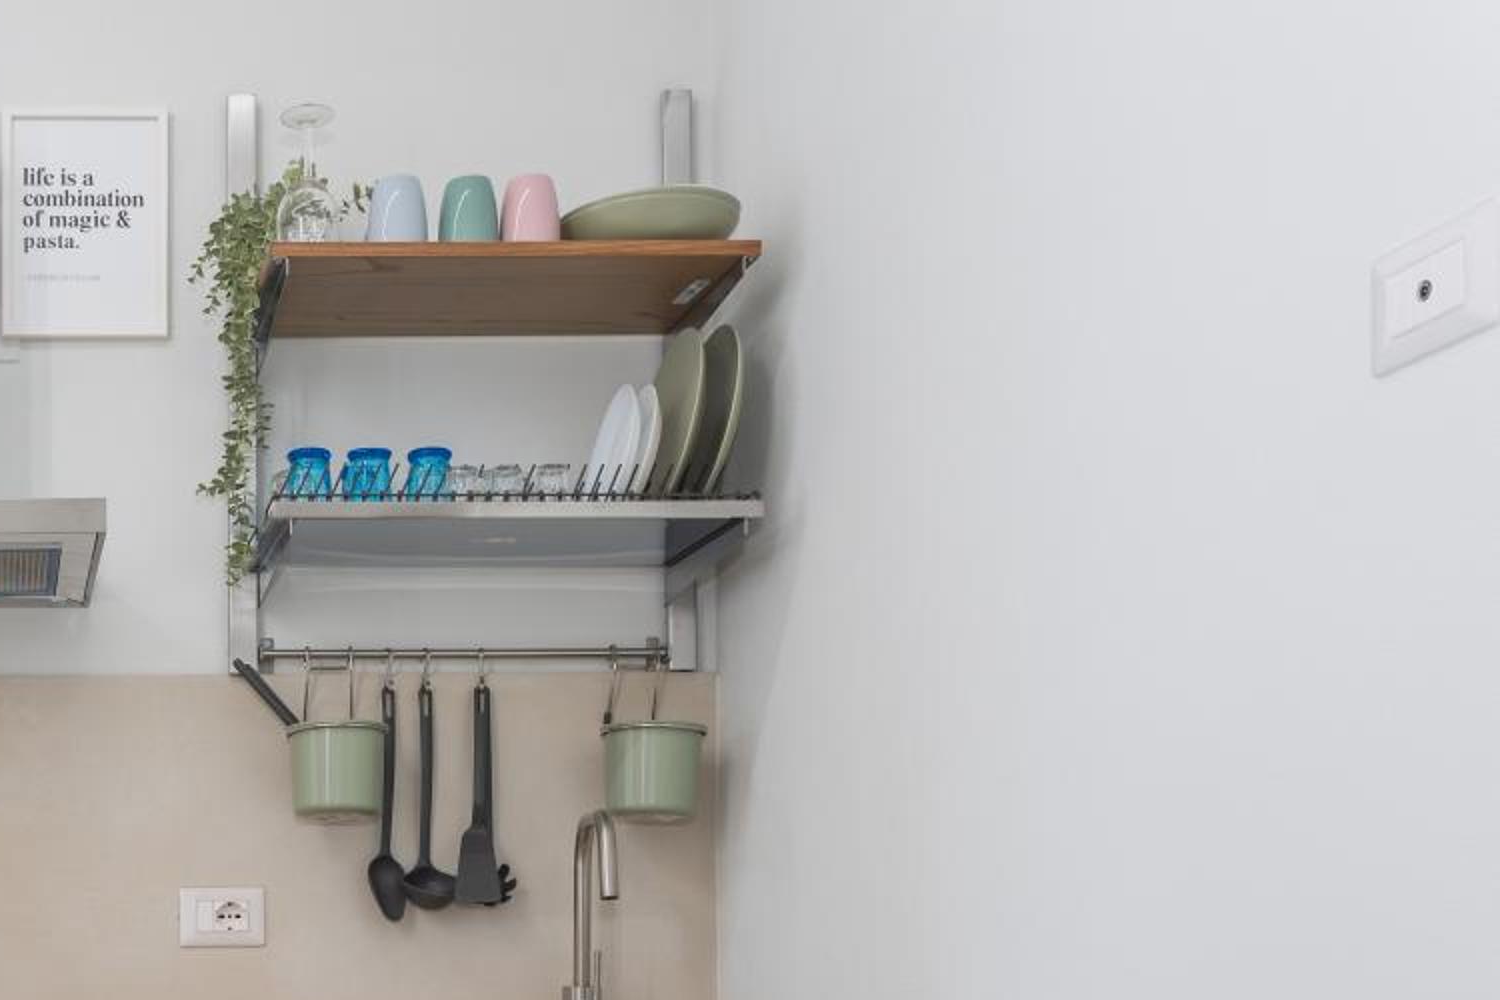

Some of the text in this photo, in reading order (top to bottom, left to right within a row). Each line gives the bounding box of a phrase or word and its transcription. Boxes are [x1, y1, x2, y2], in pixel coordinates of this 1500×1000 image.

[22, 167, 94, 187] life is a
[22, 189, 145, 207] combination
[22, 210, 132, 233] of magic &
[22, 235, 80, 253] pasta.
